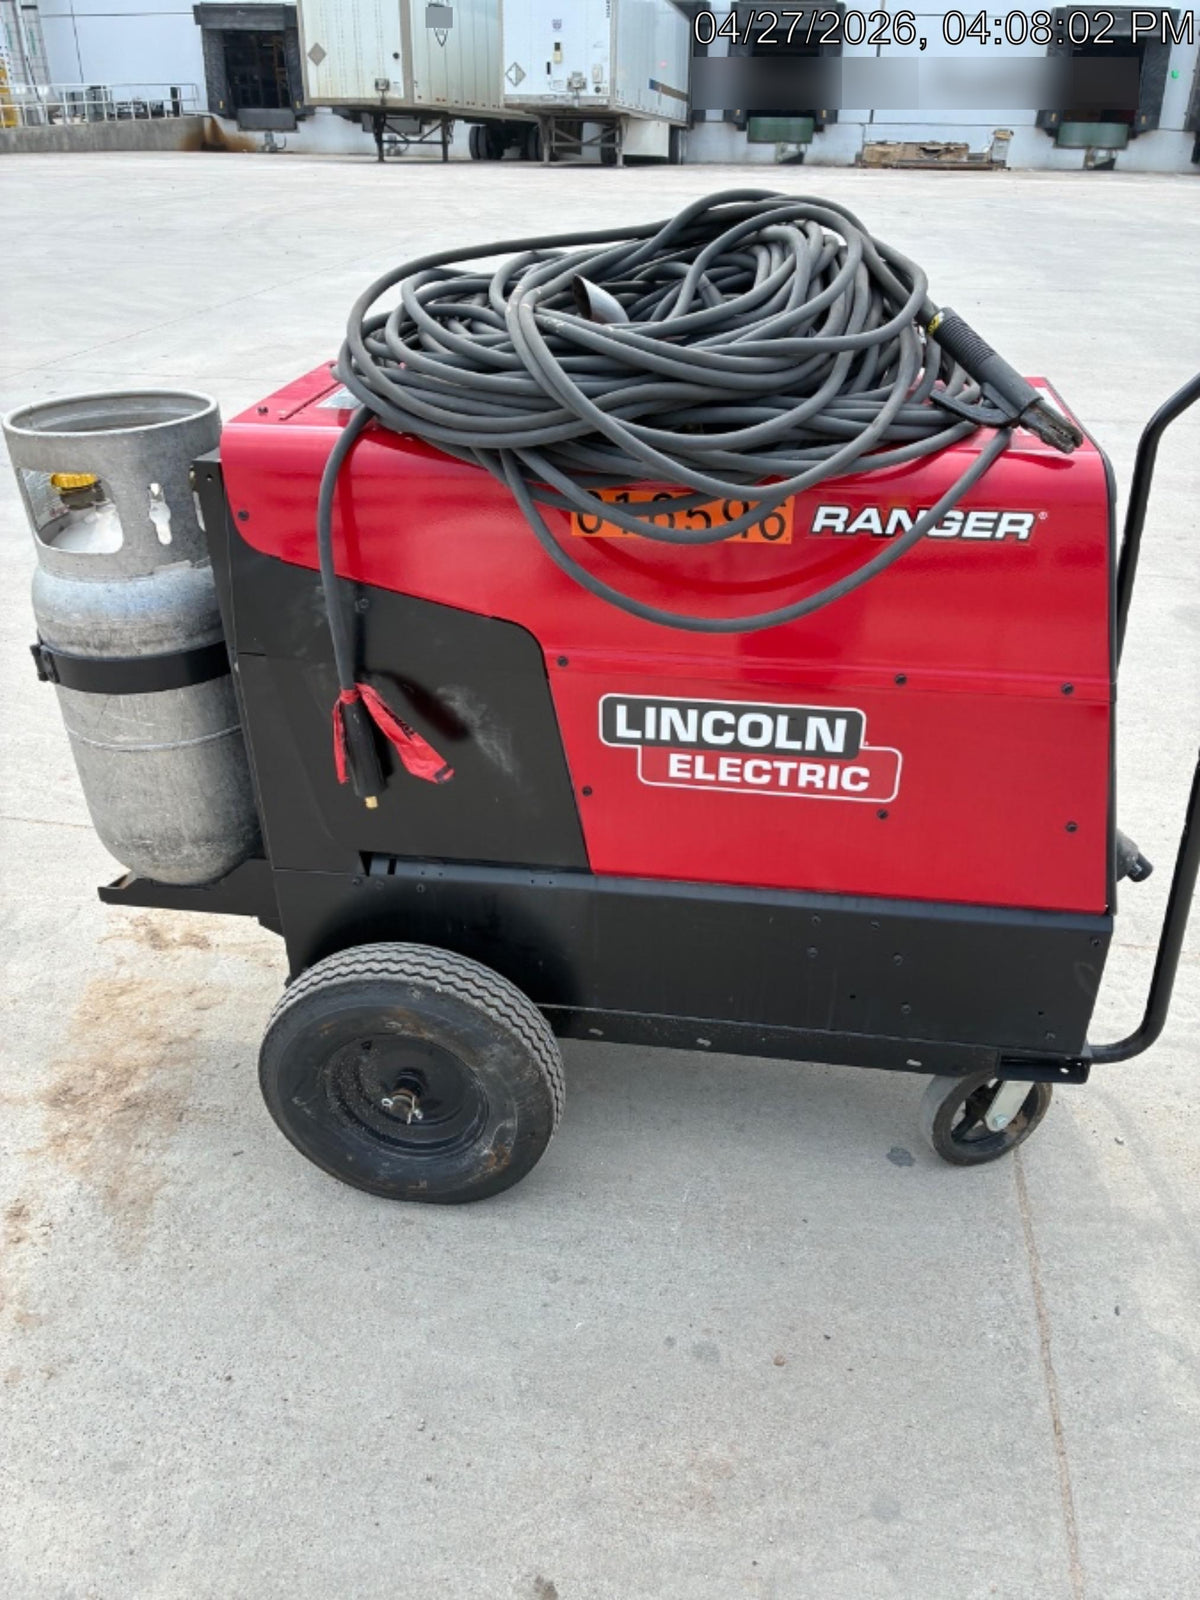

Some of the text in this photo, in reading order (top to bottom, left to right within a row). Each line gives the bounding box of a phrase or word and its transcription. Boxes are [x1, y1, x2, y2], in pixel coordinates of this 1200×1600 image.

[811, 505, 1036, 540] RANGER
[616, 704, 847, 753] LINCOLN
[668, 753, 870, 791] ELECTRIC
